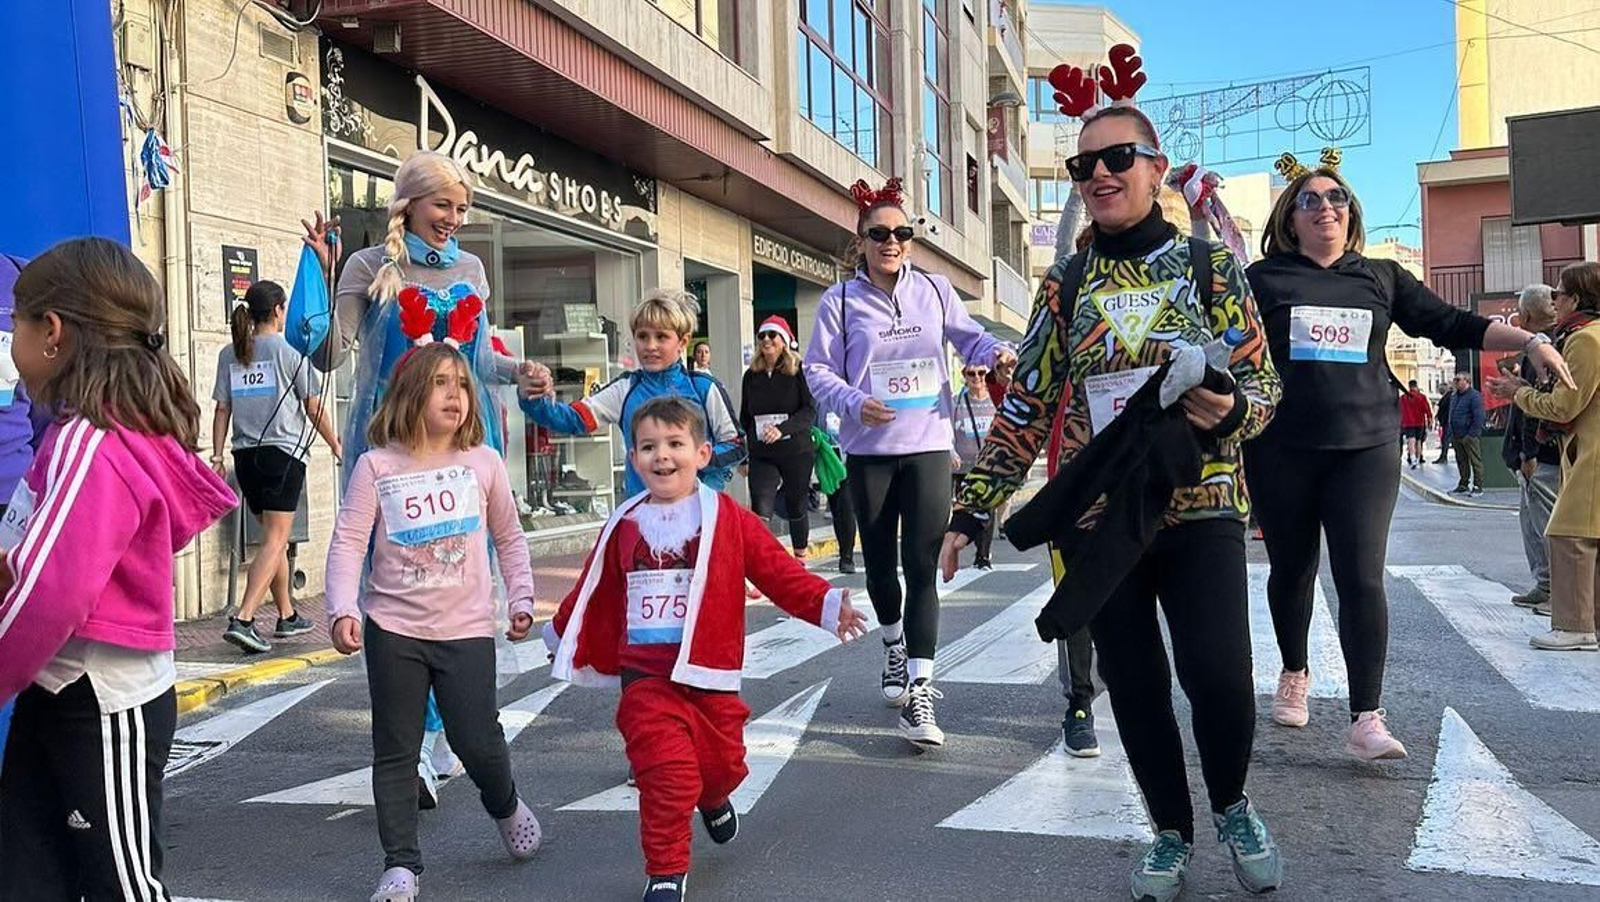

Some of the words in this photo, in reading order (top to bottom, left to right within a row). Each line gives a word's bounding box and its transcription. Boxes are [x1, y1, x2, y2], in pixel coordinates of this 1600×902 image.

[415, 74, 543, 193] Dana
[549, 171, 622, 223] SHOES
[1320, 147, 1342, 165] 25
[754, 234, 788, 264] EDIFICIO
[1103, 290, 1160, 312] GUESS
[878, 326, 921, 339] SIROKO
[1310, 325, 1349, 344] 508
[242, 372, 264, 385] 102
[888, 376, 919, 394] 531
[405, 490, 455, 519] 510
[641, 595, 687, 619] 575
